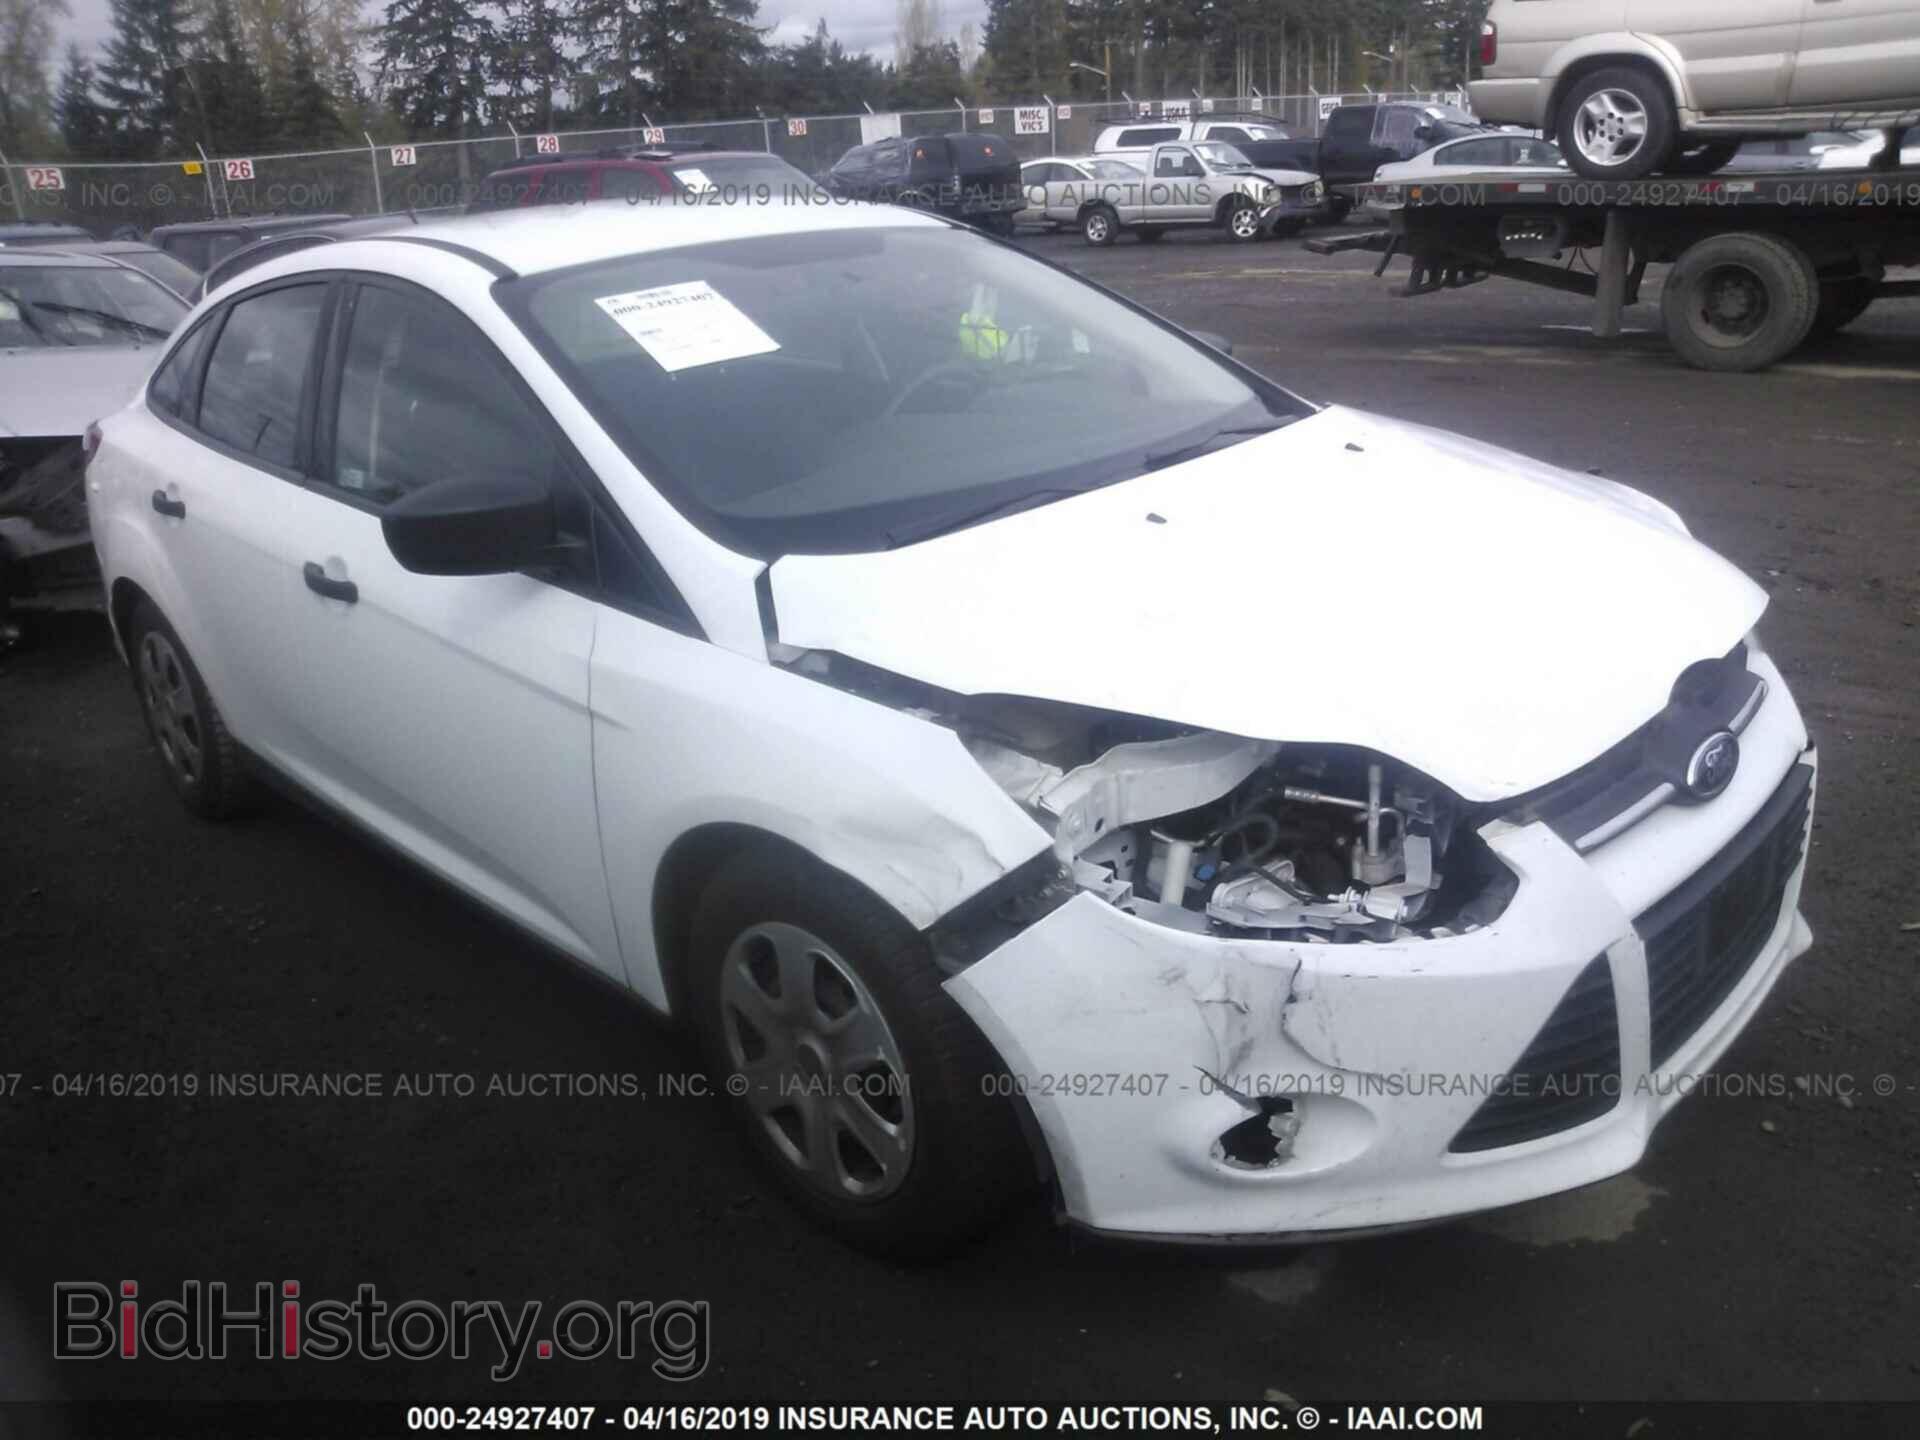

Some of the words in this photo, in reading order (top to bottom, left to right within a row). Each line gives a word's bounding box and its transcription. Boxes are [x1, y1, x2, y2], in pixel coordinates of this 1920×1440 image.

[539, 136, 556, 152] 28
[646, 128, 663, 143] 29
[394, 148, 412, 165] 27
[227, 161, 251, 179] 26
[30, 170, 61, 188] 25
